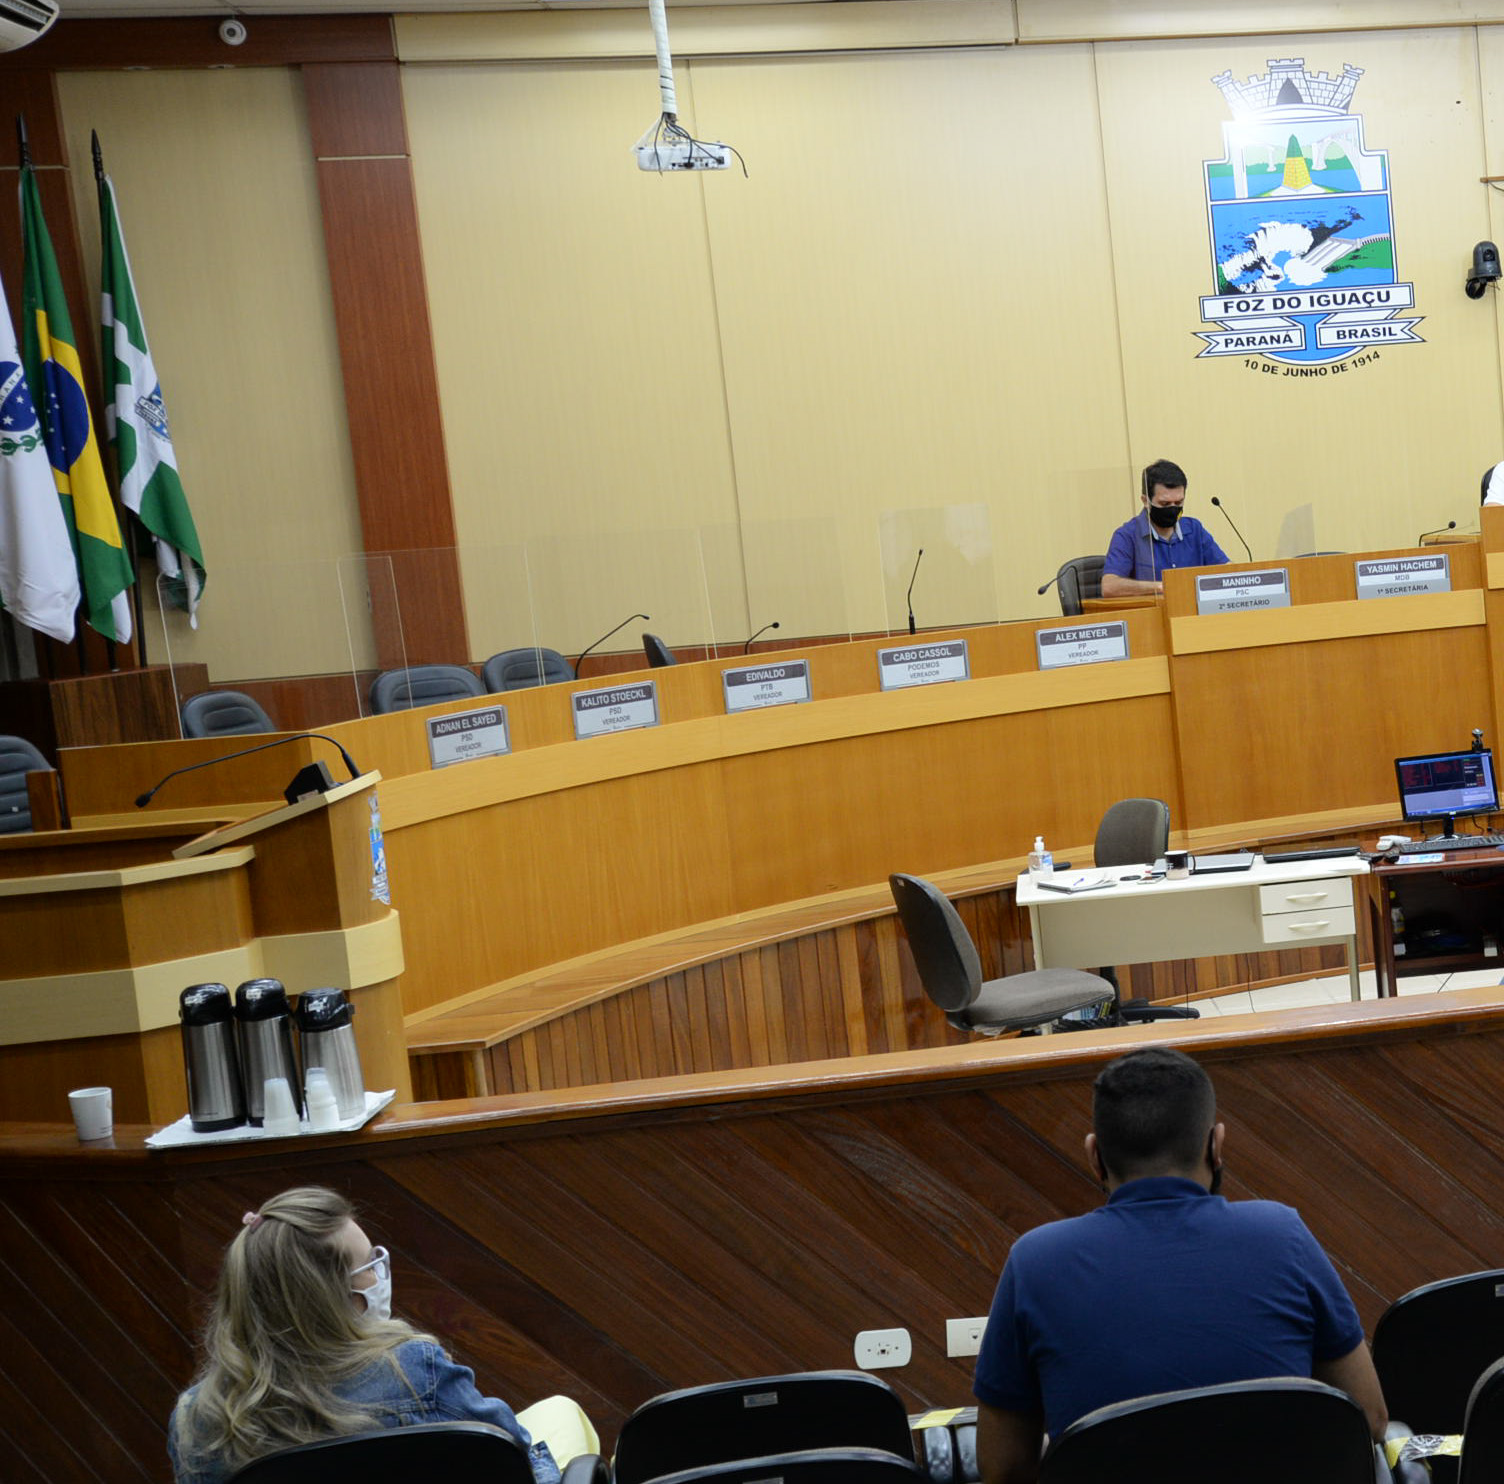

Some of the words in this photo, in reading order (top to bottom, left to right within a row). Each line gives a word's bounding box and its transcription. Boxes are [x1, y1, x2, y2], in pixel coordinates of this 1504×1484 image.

[1223, 299, 1265, 314] FOZ
[1273, 296, 1302, 311] DO
[1310, 291, 1391, 308] IGUAÇU
[1336, 326, 1398, 340] BRASIL
[1224, 332, 1293, 348] PARANÁ
[1244, 359, 1258, 370] 10
[1262, 364, 1279, 375] DE
[1283, 367, 1328, 378] JUNHO
[1332, 363, 1348, 375] DE
[1352, 350, 1381, 368] 1914
[1367, 564, 1398, 574] YASMIN
[1401, 561, 1437, 571] HACHEM
[1222, 576, 1261, 587] MANINHO
[1385, 584, 1428, 594] SECRETÁRIA
[1227, 599, 1270, 609] SECRETÁRIO
[1056, 632, 1077, 642] ALEX
[1079, 629, 1108, 639] MEYER
[893, 651, 917, 662] CABO
[919, 648, 952, 659] CASSOL
[1068, 650, 1099, 659] VEREADOR
[908, 661, 940, 671] PODEMOS
[746, 669, 786, 682] EDIVALDO
[910, 670, 940, 679] VEREADOR
[582, 695, 609, 708] KALITO
[610, 689, 646, 703] STOECKL
[753, 691, 783, 701] VEREADOR
[609, 707, 622, 716] PSD
[436, 720, 461, 734] ADNAN
[462, 719, 472, 728] EL
[472, 714, 497, 727] SAYED
